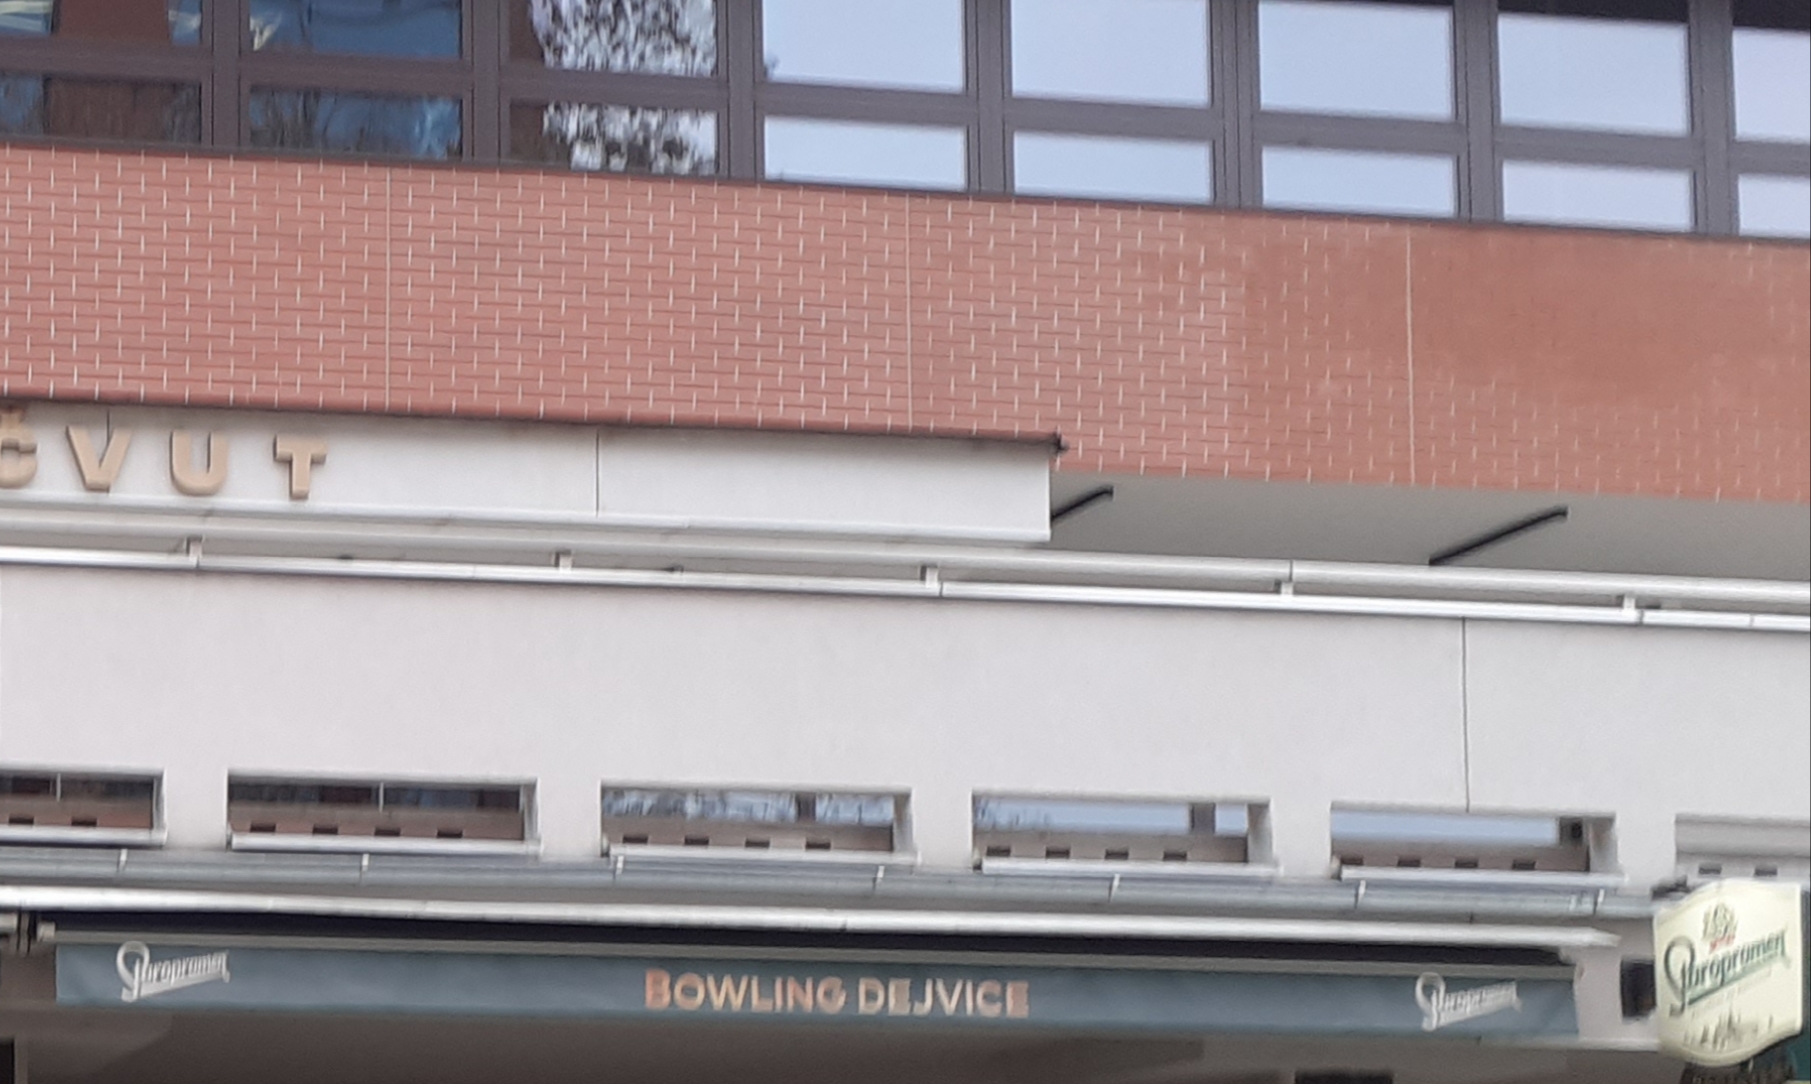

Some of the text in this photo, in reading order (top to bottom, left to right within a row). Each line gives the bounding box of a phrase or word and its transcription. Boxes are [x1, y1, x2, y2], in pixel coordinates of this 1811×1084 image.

[644, 968, 1030, 1019] BOWLING DEJVICE
[1663, 930, 1792, 1018] Staropramen
